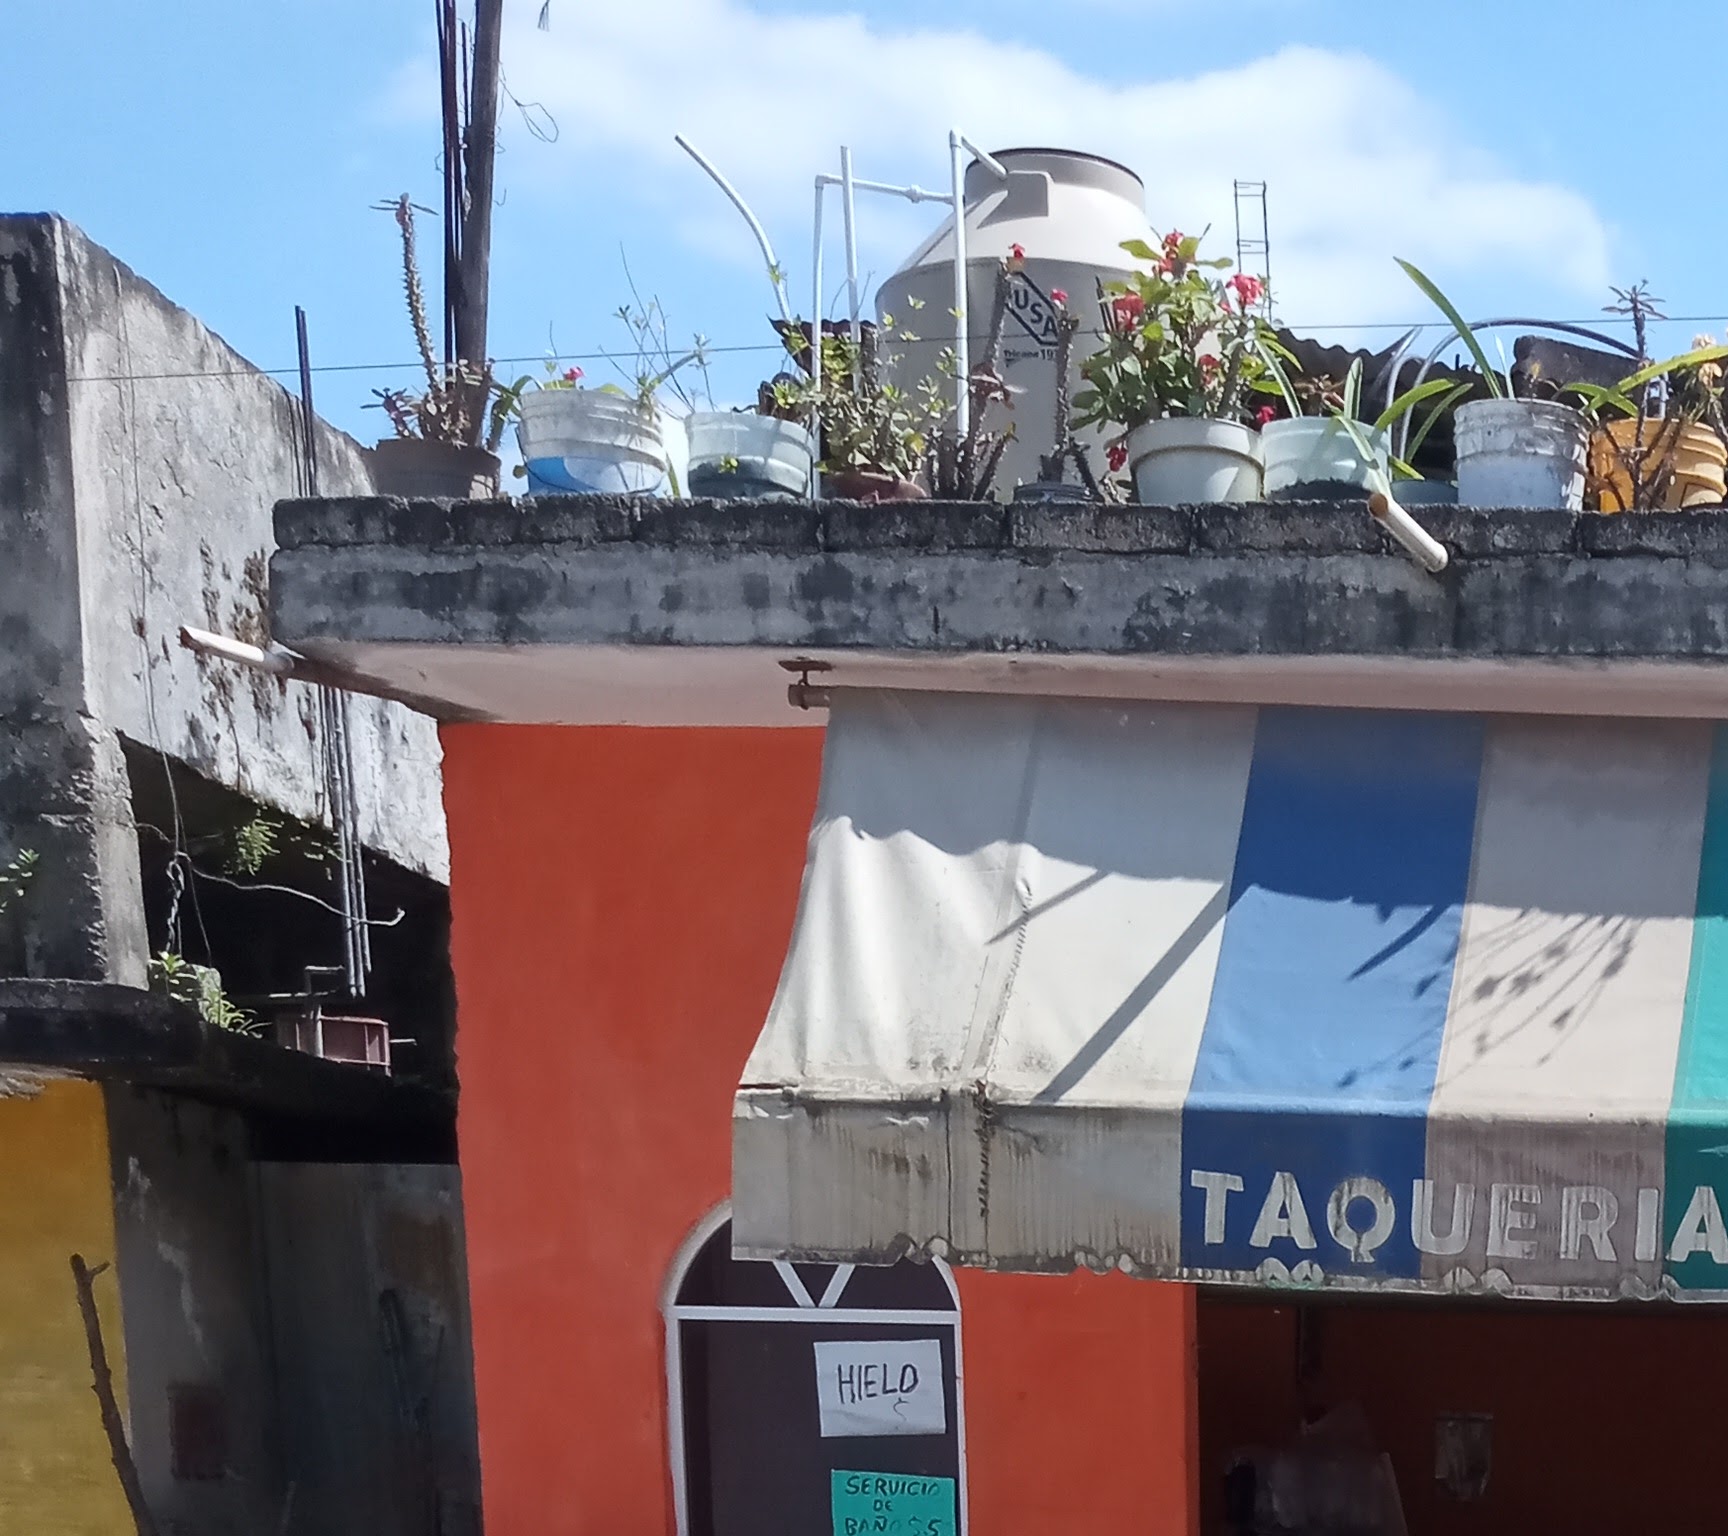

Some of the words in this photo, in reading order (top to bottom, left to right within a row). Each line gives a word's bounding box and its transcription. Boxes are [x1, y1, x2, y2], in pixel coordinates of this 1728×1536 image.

[837, 1363, 919, 1404] HIELO
[845, 1475, 940, 1496] SERVICIO
[873, 1498, 893, 1512] DE
